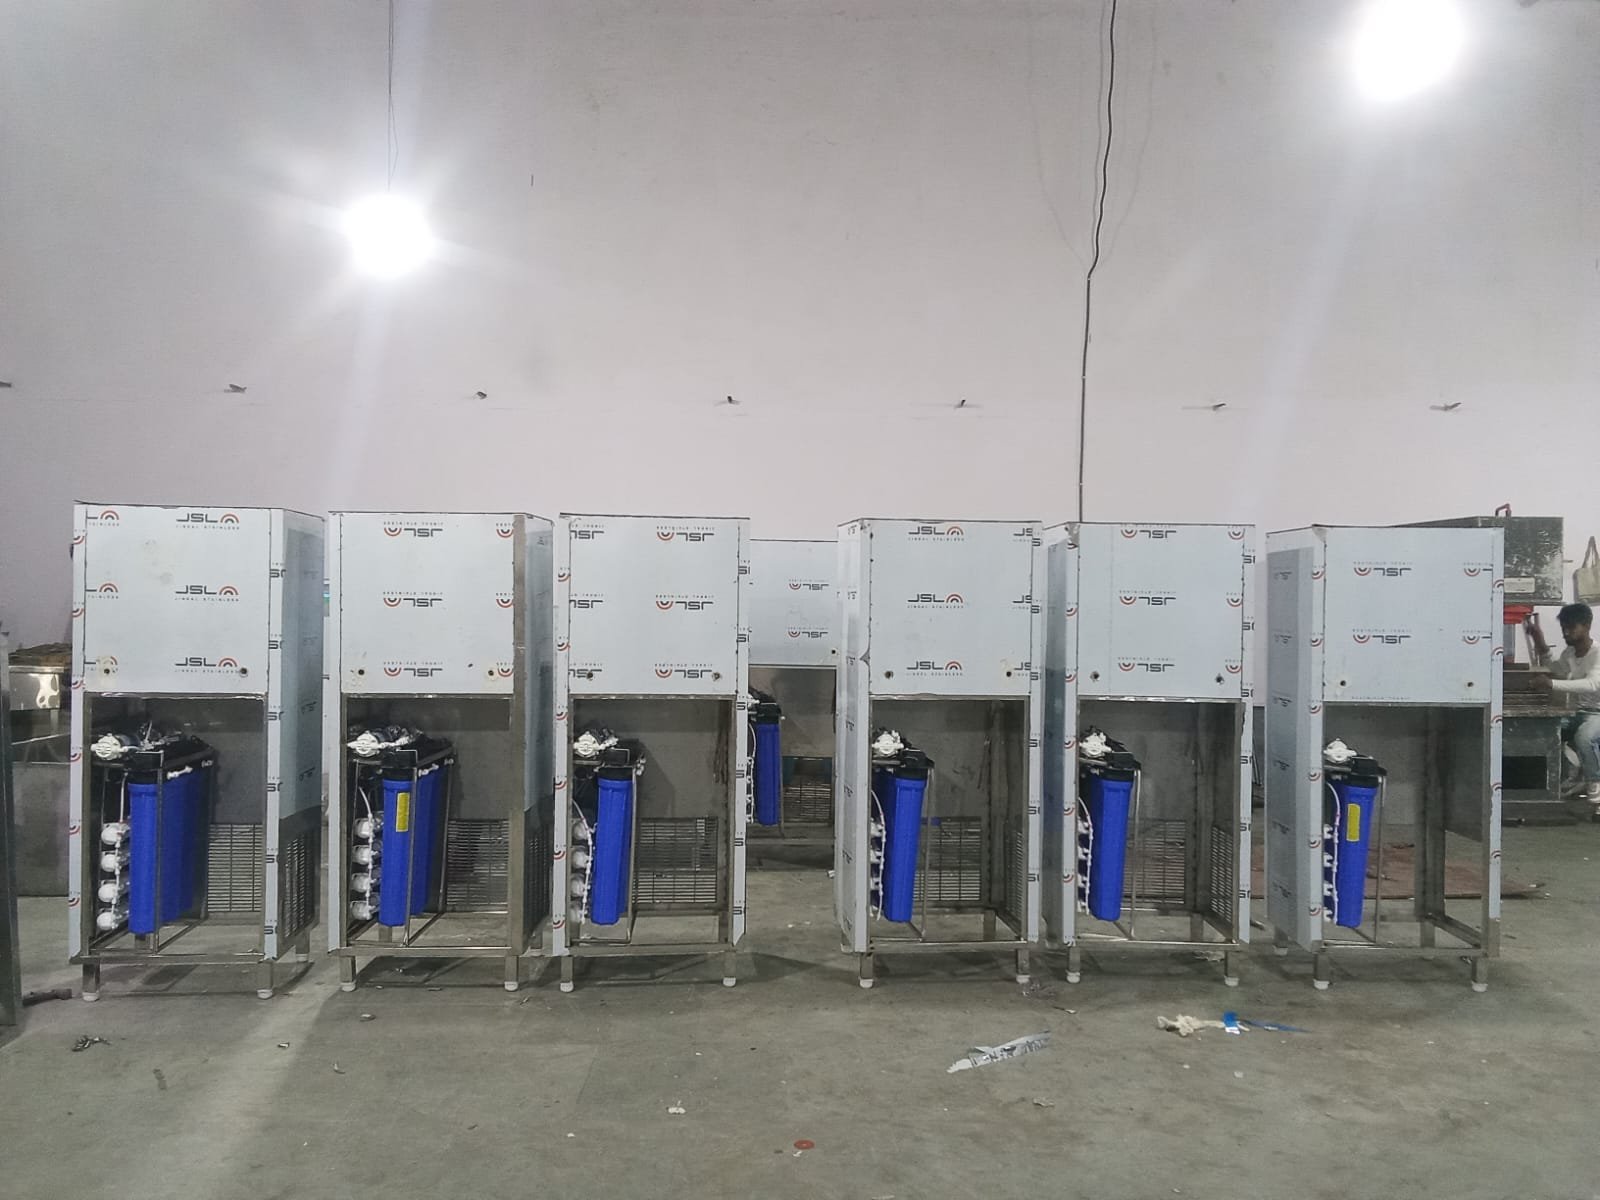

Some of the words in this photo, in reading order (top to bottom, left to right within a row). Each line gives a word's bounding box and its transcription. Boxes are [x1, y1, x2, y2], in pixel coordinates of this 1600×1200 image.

[176, 512, 218, 523] JSL
[403, 528, 443, 537] JSL
[908, 526, 945, 536] JSL
[1139, 530, 1177, 538] JSL
[676, 532, 714, 541] JSL
[1373, 567, 1411, 577] JSL
[175, 585, 217, 595] JSL
[403, 598, 443, 607] JSL
[907, 594, 945, 603] JSL
[1138, 597, 1176, 605] JSL
[675, 601, 714, 610] JSL
[1372, 635, 1411, 644] JSL
[175, 657, 217, 667] JSL
[906, 661, 944, 671] JSL
[1137, 663, 1175, 672] JSL
[403, 668, 443, 677] JSL
[674, 669, 714, 679] JSL
